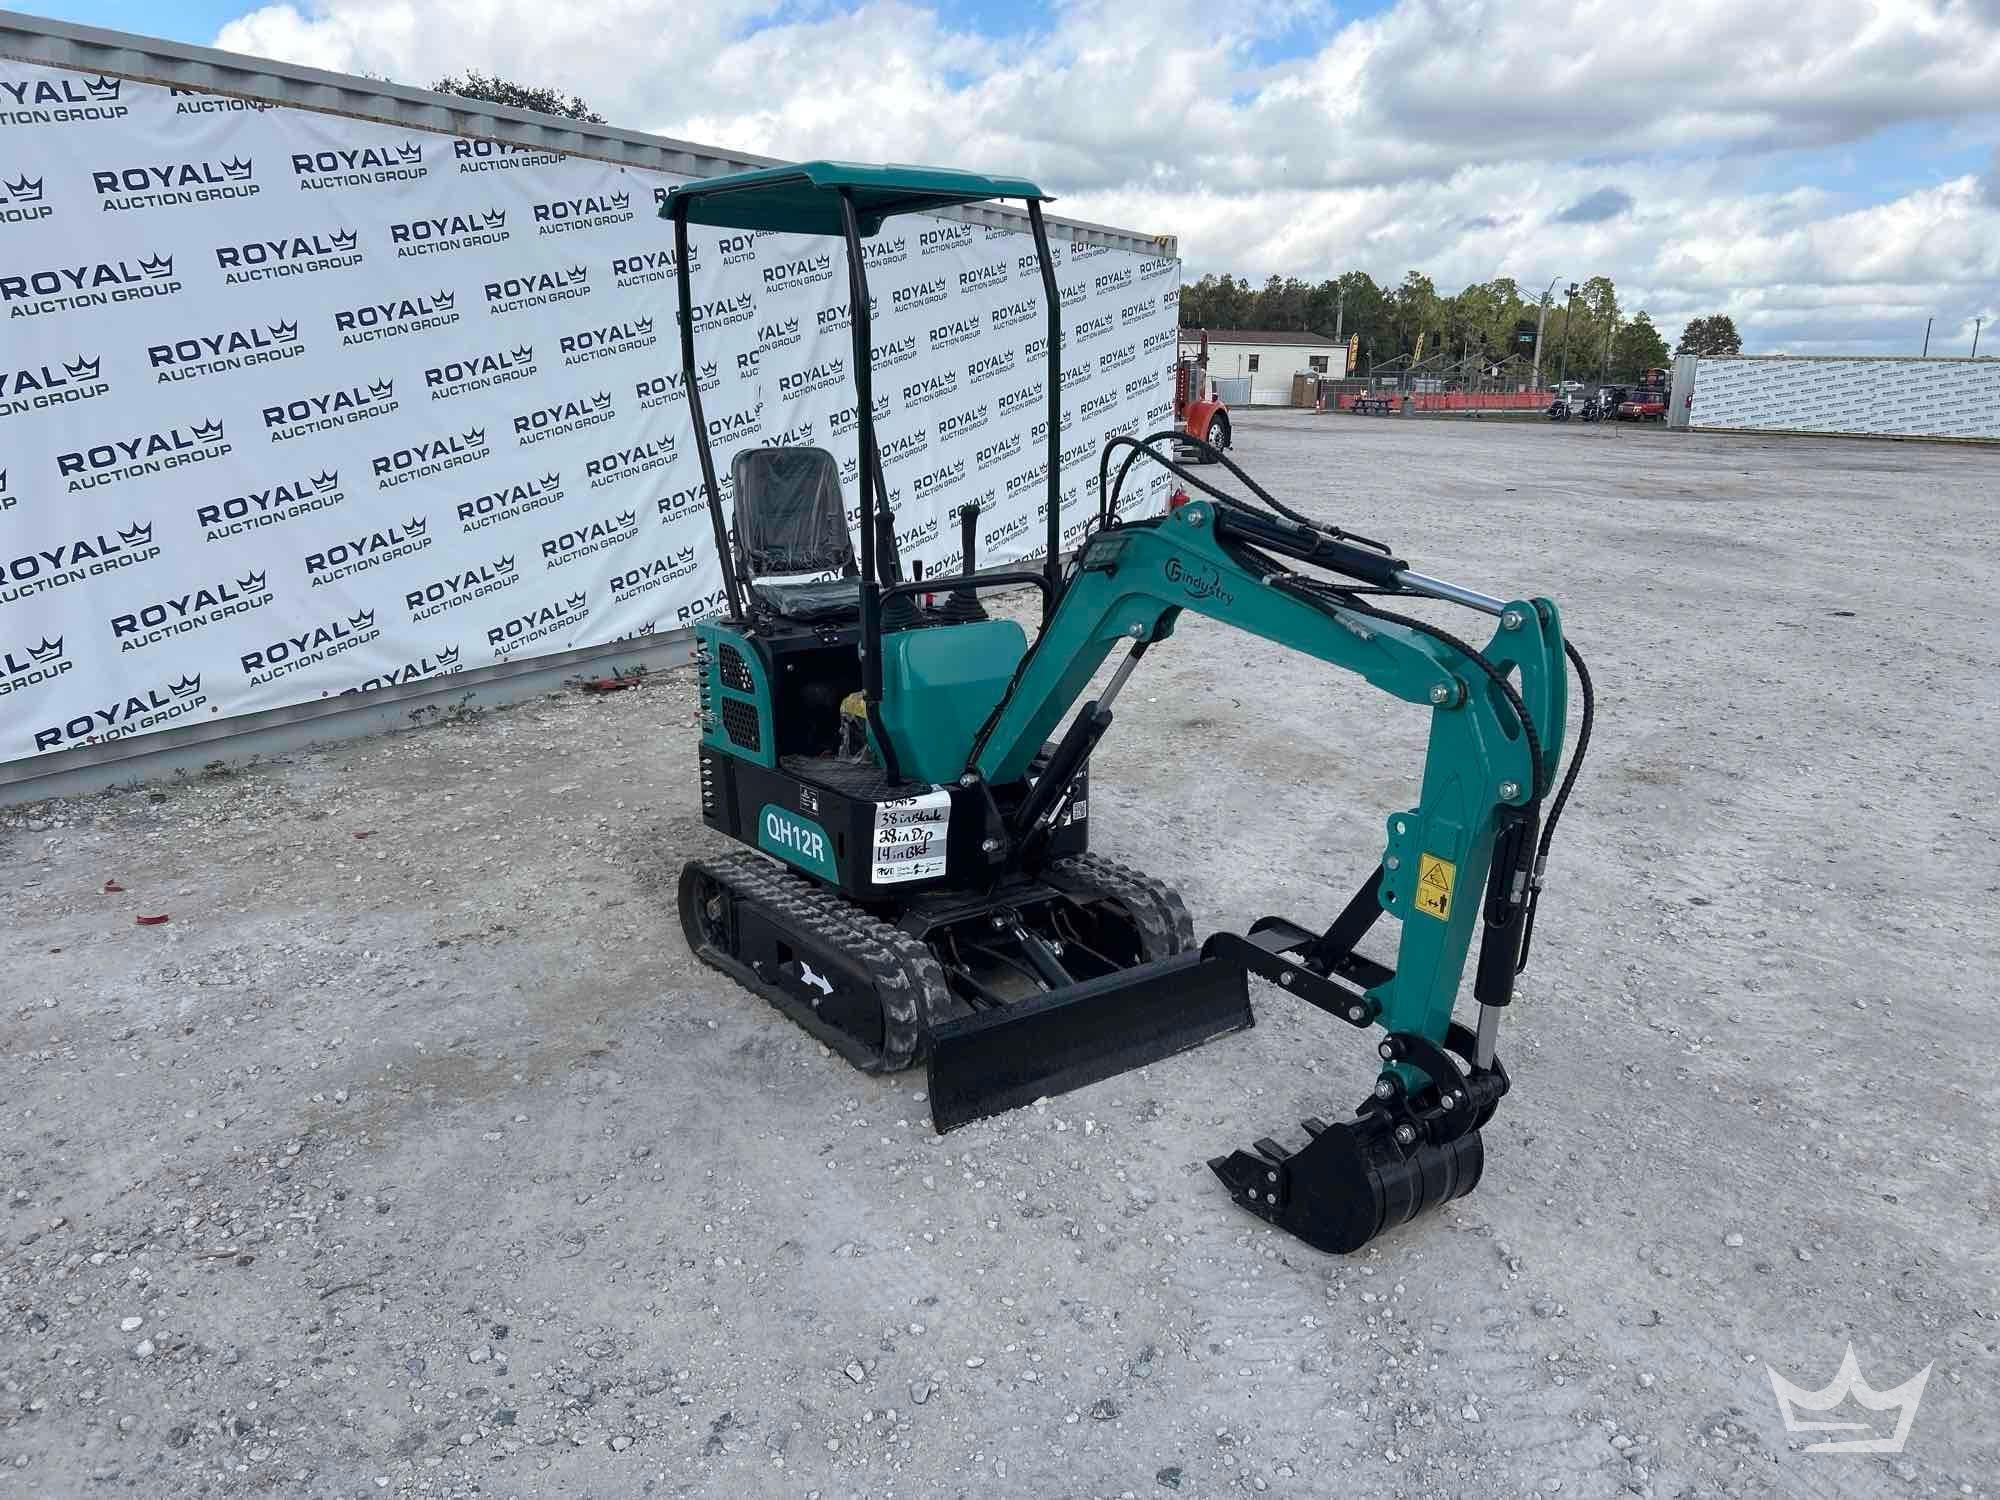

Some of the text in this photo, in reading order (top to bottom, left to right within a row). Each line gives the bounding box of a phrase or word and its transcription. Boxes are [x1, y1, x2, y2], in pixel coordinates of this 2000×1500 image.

[54, 107, 130, 123] GROUP
[178, 100, 261, 116] AUCTION
[293, 146, 399, 175] ROYAL
[460, 153, 563, 173] AUCTION GROUP
[93, 162, 224, 194] ROYAL
[300, 167, 426, 190] AUCTION GROUP
[103, 184, 258, 212] AUCTION GROUP
[534, 195, 612, 222] ROYAL
[390, 214, 484, 244] ROYAL
[539, 212, 632, 235] AUCTION GROUP
[919, 226, 961, 246] ROYAL
[217, 235, 332, 269] ROYAL
[397, 231, 508, 258] AUCTION GROUP
[0, 260, 142, 301] ROYAL
[226, 253, 362, 285] AUCTION GROUP
[617, 270, 664, 288] AUCTION
[762, 258, 817, 283] ROYAL
[765, 271, 831, 293] AUCTION GROUP
[959, 264, 997, 285] ROYAL
[1095, 270, 1123, 288] ROYAL
[9, 281, 179, 318] AUCTION GROUP
[485, 270, 567, 301] ROYAL
[490, 286, 589, 315] AUCTION GROUP
[892, 281, 935, 304] ROYAL
[334, 296, 434, 332] ROYAL
[692, 310, 754, 333] CTION GROUP
[992, 301, 1027, 322] ROYAL
[1121, 301, 1148, 319] ROYAL
[341, 312, 460, 346] AUCTION GROUP
[561, 322, 635, 354] ROYAL
[771, 334, 800, 349] GROUP
[819, 319, 853, 335] AUCTION
[930, 319, 970, 342] ROYAL
[1075, 316, 1105, 336] ROYAL
[149, 327, 271, 368] ROYAL
[566, 336, 654, 366] AUCTION GROUP
[869, 340, 905, 361] OYAL
[893, 350, 916, 364] GROUP
[1100, 347, 1128, 367] ROYAL
[158, 344, 303, 384] AUCTION GROUP
[424, 352, 513, 388] ROYAL
[779, 363, 831, 391] ROYAL
[967, 353, 1004, 376] ROYAL
[31, 383, 107, 409] GROUP
[430, 365, 536, 401] AUCTION GROUP
[636, 367, 702, 399] ROYA
[782, 374, 844, 401] AUCTION GROUP
[903, 375, 944, 400] ROYAL
[999, 386, 1033, 409] ROYAL
[264, 387, 371, 428] ROYAL
[640, 389, 686, 410] AUCTION
[1080, 393, 1109, 414] ROYAL
[271, 401, 399, 442] AUCTION GROUP
[514, 398, 592, 434] ROYAL
[519, 410, 613, 446] AUCTION GROUP
[708, 409, 755, 436] OYAL
[939, 408, 978, 434] ROYAL
[58, 428, 192, 477] ROYAL
[705, 430, 740, 449] UCTION
[975, 438, 1011, 463] ROYAL
[68, 443, 227, 493] AUCTION GROUP
[371, 435, 465, 476] ROYAL
[378, 448, 490, 490] AUCTION GROUP
[587, 442, 657, 478] ROYAL
[591, 452, 676, 489] AUCTION GROUP
[914, 464, 954, 492] ROYAL
[1006, 467, 1039, 492] ROYAL
[199, 480, 314, 528] ROYAL
[457, 480, 541, 521] ROYAL
[463, 491, 563, 533] AUCTION GROUP
[658, 482, 711, 514] ROYA
[662, 501, 705, 525] AUCTION
[207, 492, 344, 542] AUCTION GROUP
[984, 519, 1019, 546] ROYAL
[304, 527, 405, 574] ROYAL
[542, 518, 617, 558] ROYAL
[547, 527, 636, 569] AUCTION GROUP
[87, 546, 158, 577] GROUP
[311, 537, 432, 587] AUCTION GROUP
[610, 554, 678, 594] ROYAL
[406, 564, 495, 610] ROYAL
[412, 573, 518, 623] AUCTION GROUP
[614, 562, 695, 604] AUCTION GROUP
[113, 583, 238, 638] ROYAL
[677, 589, 728, 623] ROYA
[122, 593, 270, 653] AUCTION GROUP
[487, 601, 567, 646] ROYAL
[493, 608, 588, 657] AUCTION GROUP
[242, 620, 350, 674] ROYAL
[250, 629, 378, 687] AUCTION GROUP
[0, 661, 71, 696] GROUP
[36, 688, 171, 752] ROYAL
[139, 695, 205, 729] GROUP
[767, 812, 824, 862] QH12R
